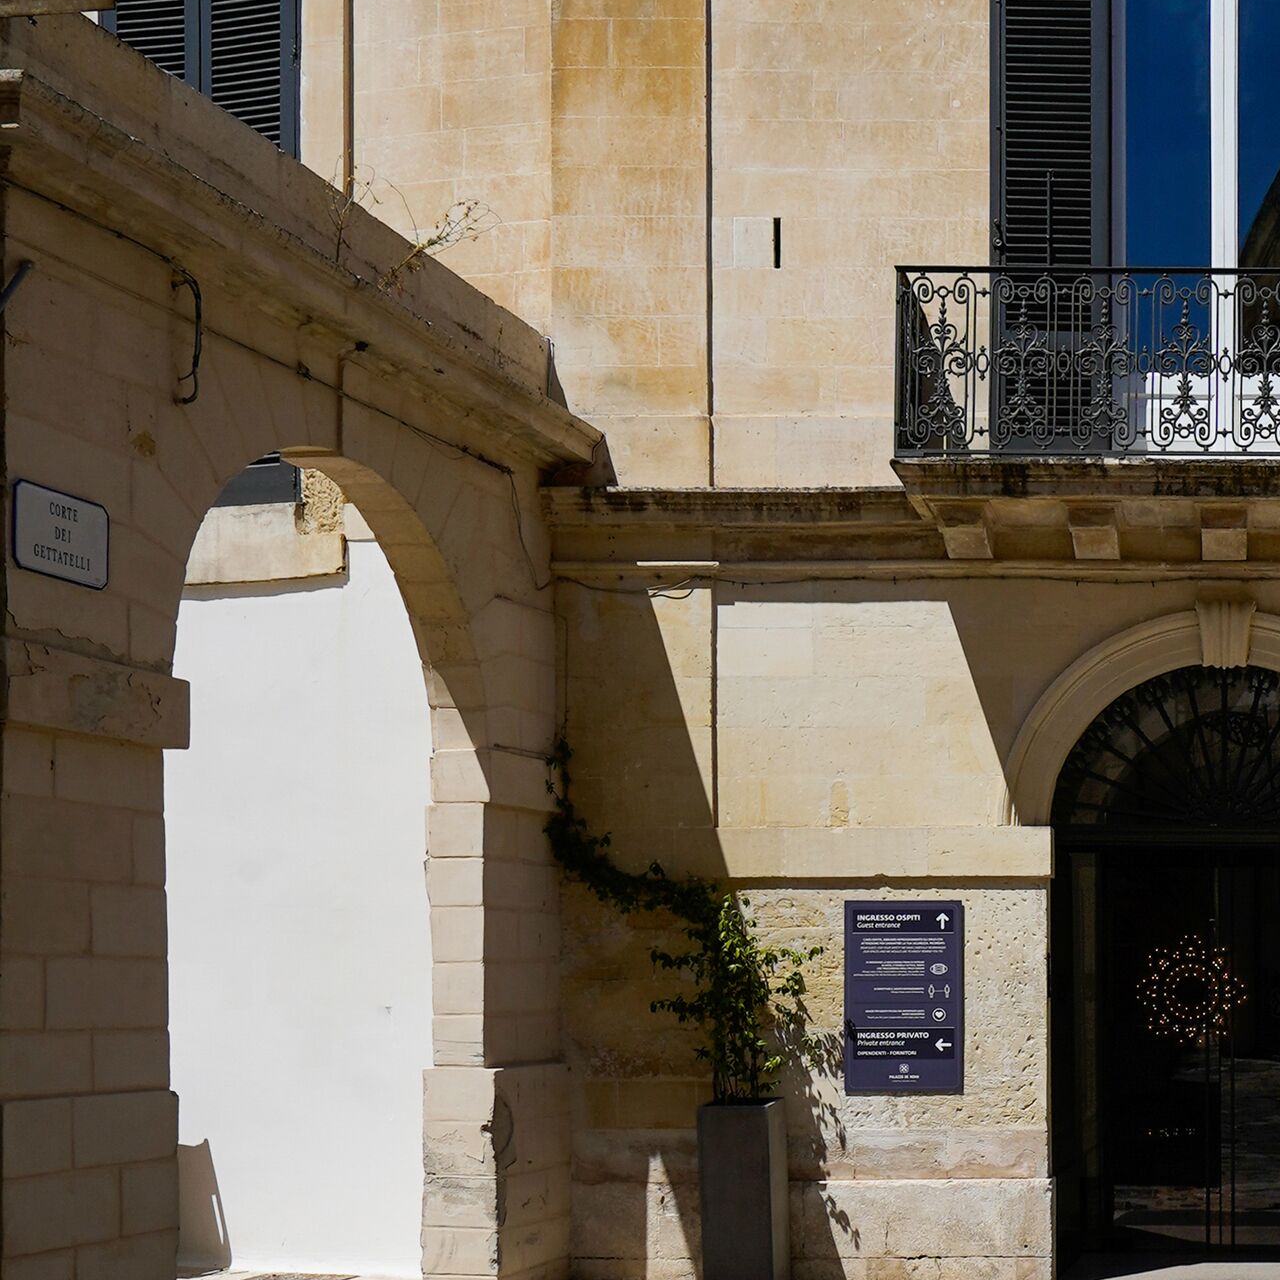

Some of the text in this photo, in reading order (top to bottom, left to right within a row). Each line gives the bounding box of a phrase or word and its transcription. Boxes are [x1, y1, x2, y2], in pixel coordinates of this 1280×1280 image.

[49, 502, 79, 522] CORTE
[54, 526, 71, 543] DEI
[33, 543, 90, 571] GETTATELLI
